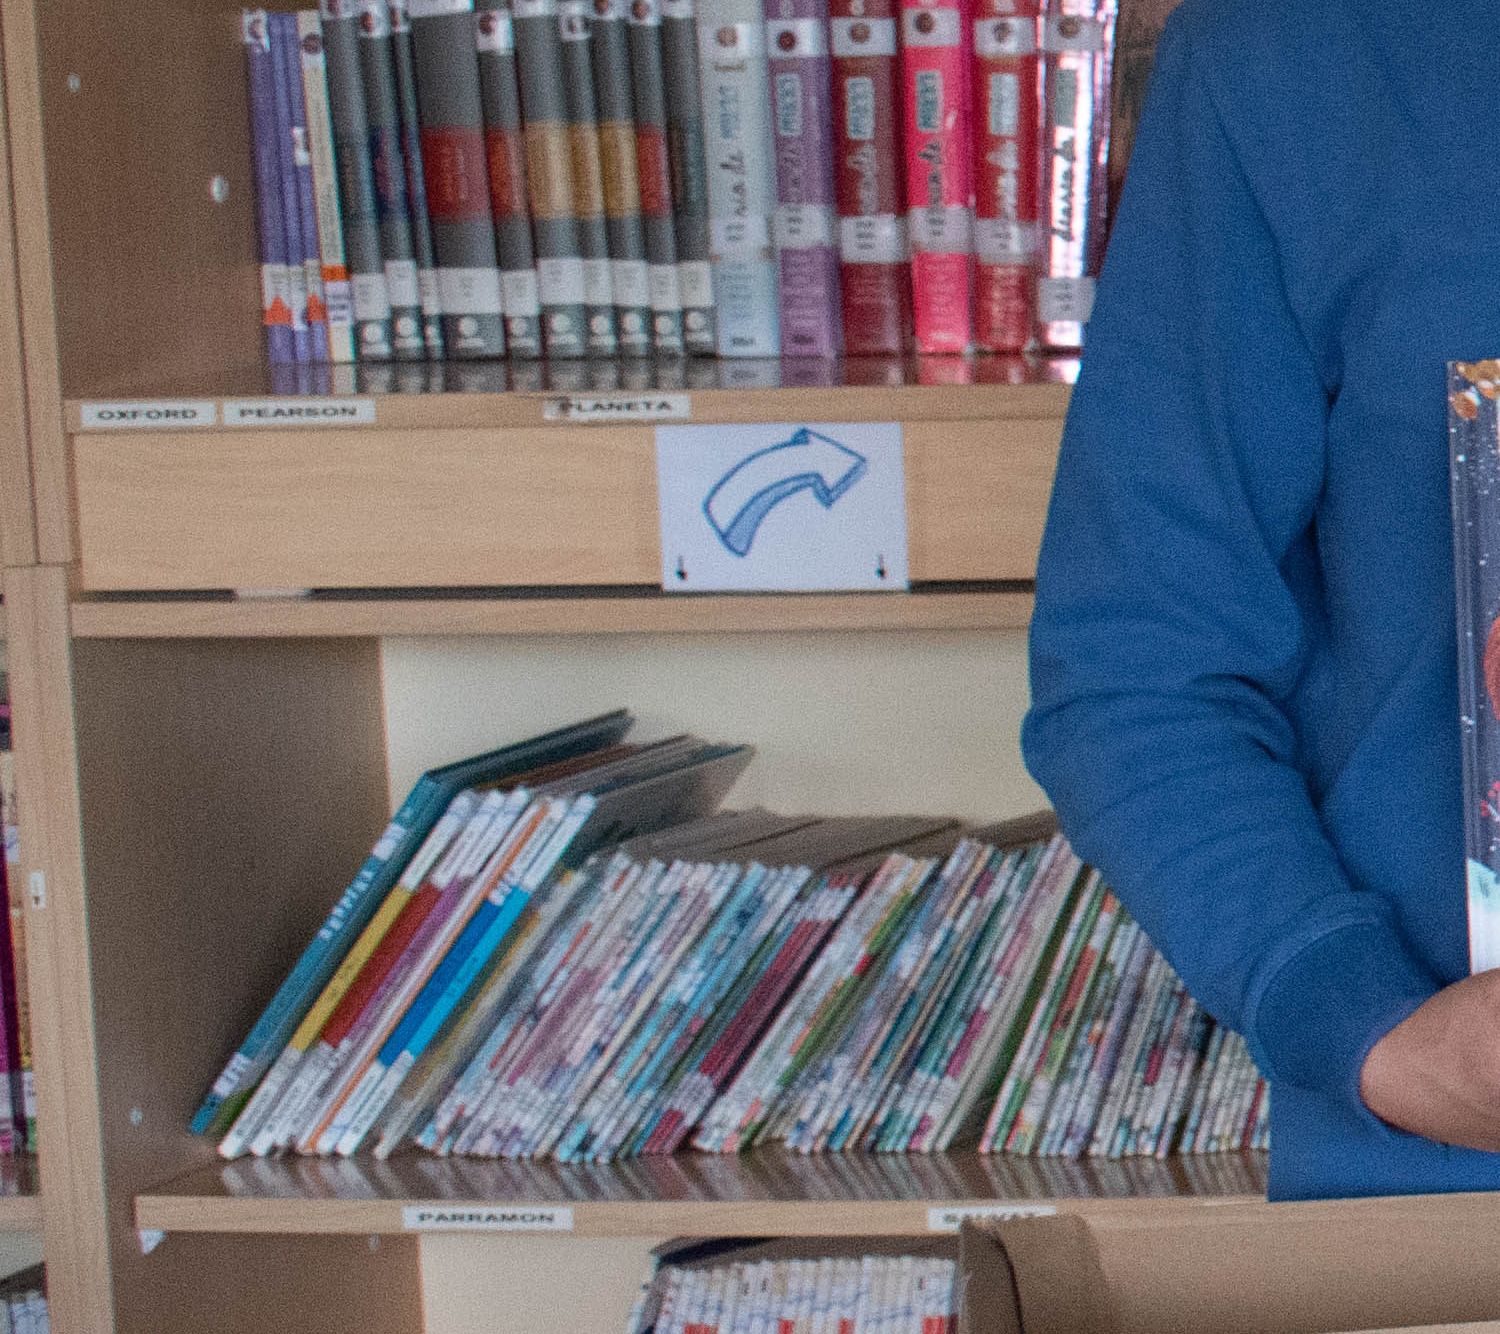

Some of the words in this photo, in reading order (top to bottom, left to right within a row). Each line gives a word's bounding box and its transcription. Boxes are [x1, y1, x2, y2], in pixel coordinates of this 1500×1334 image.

[97, 409, 199, 421] OXFORD
[239, 406, 357, 419] PEARSON
[418, 1211, 556, 1224] PARRAMON
